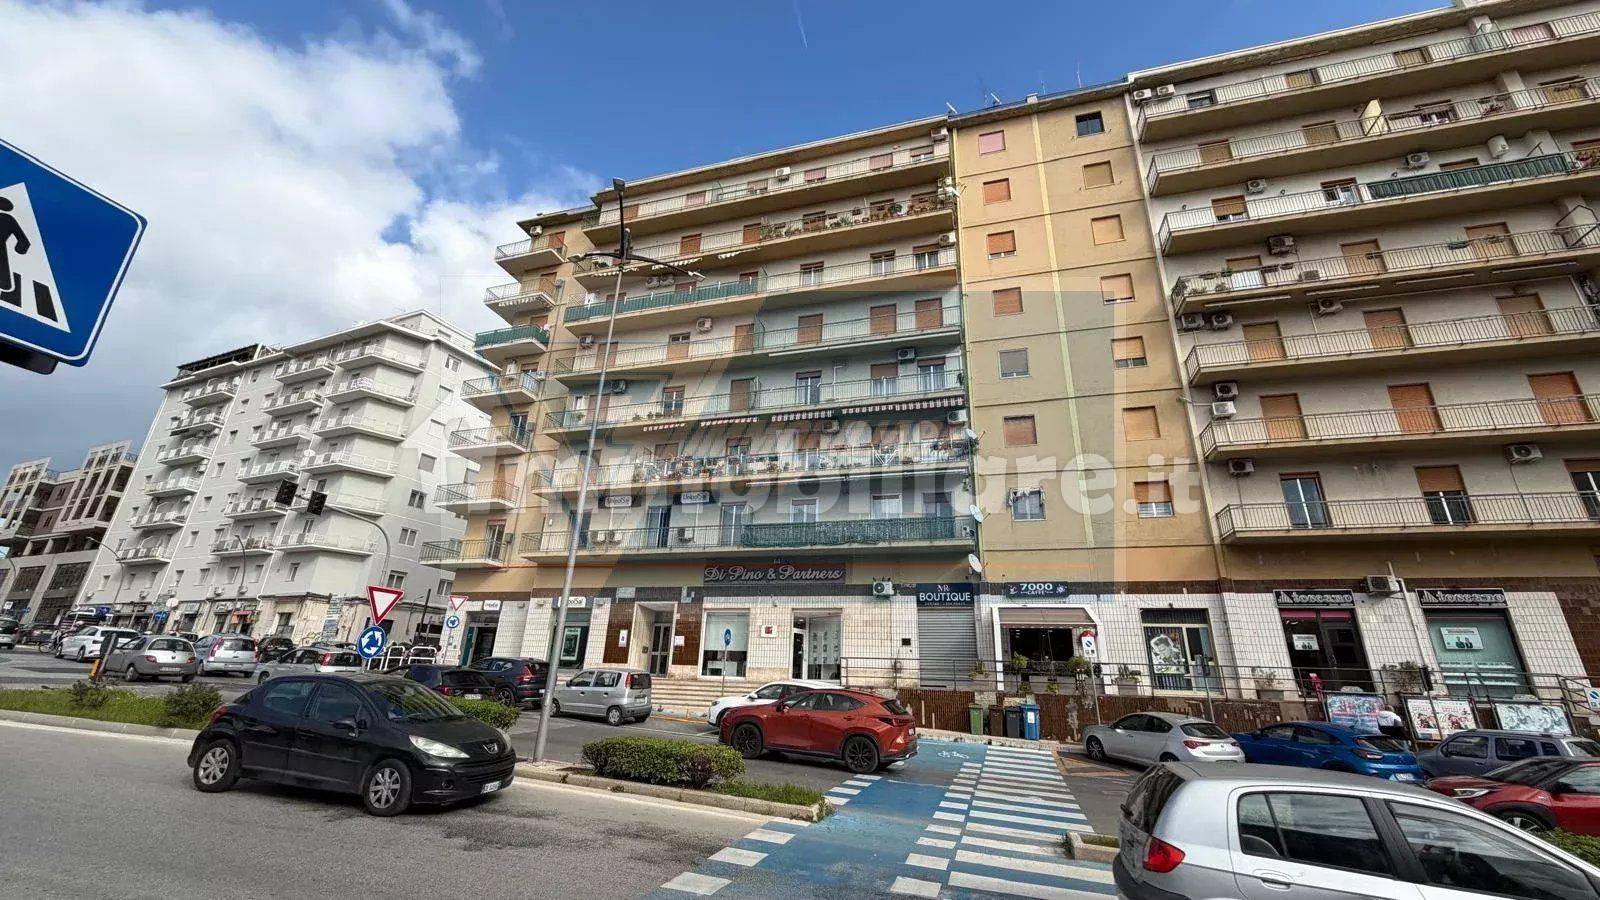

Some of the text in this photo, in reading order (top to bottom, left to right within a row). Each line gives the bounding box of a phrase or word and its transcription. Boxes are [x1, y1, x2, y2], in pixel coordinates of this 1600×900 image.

[704, 564, 843, 581] Di Pino & Partners
[1019, 582, 1053, 592] 7000
[919, 592, 971, 602] BOUTIQUE
